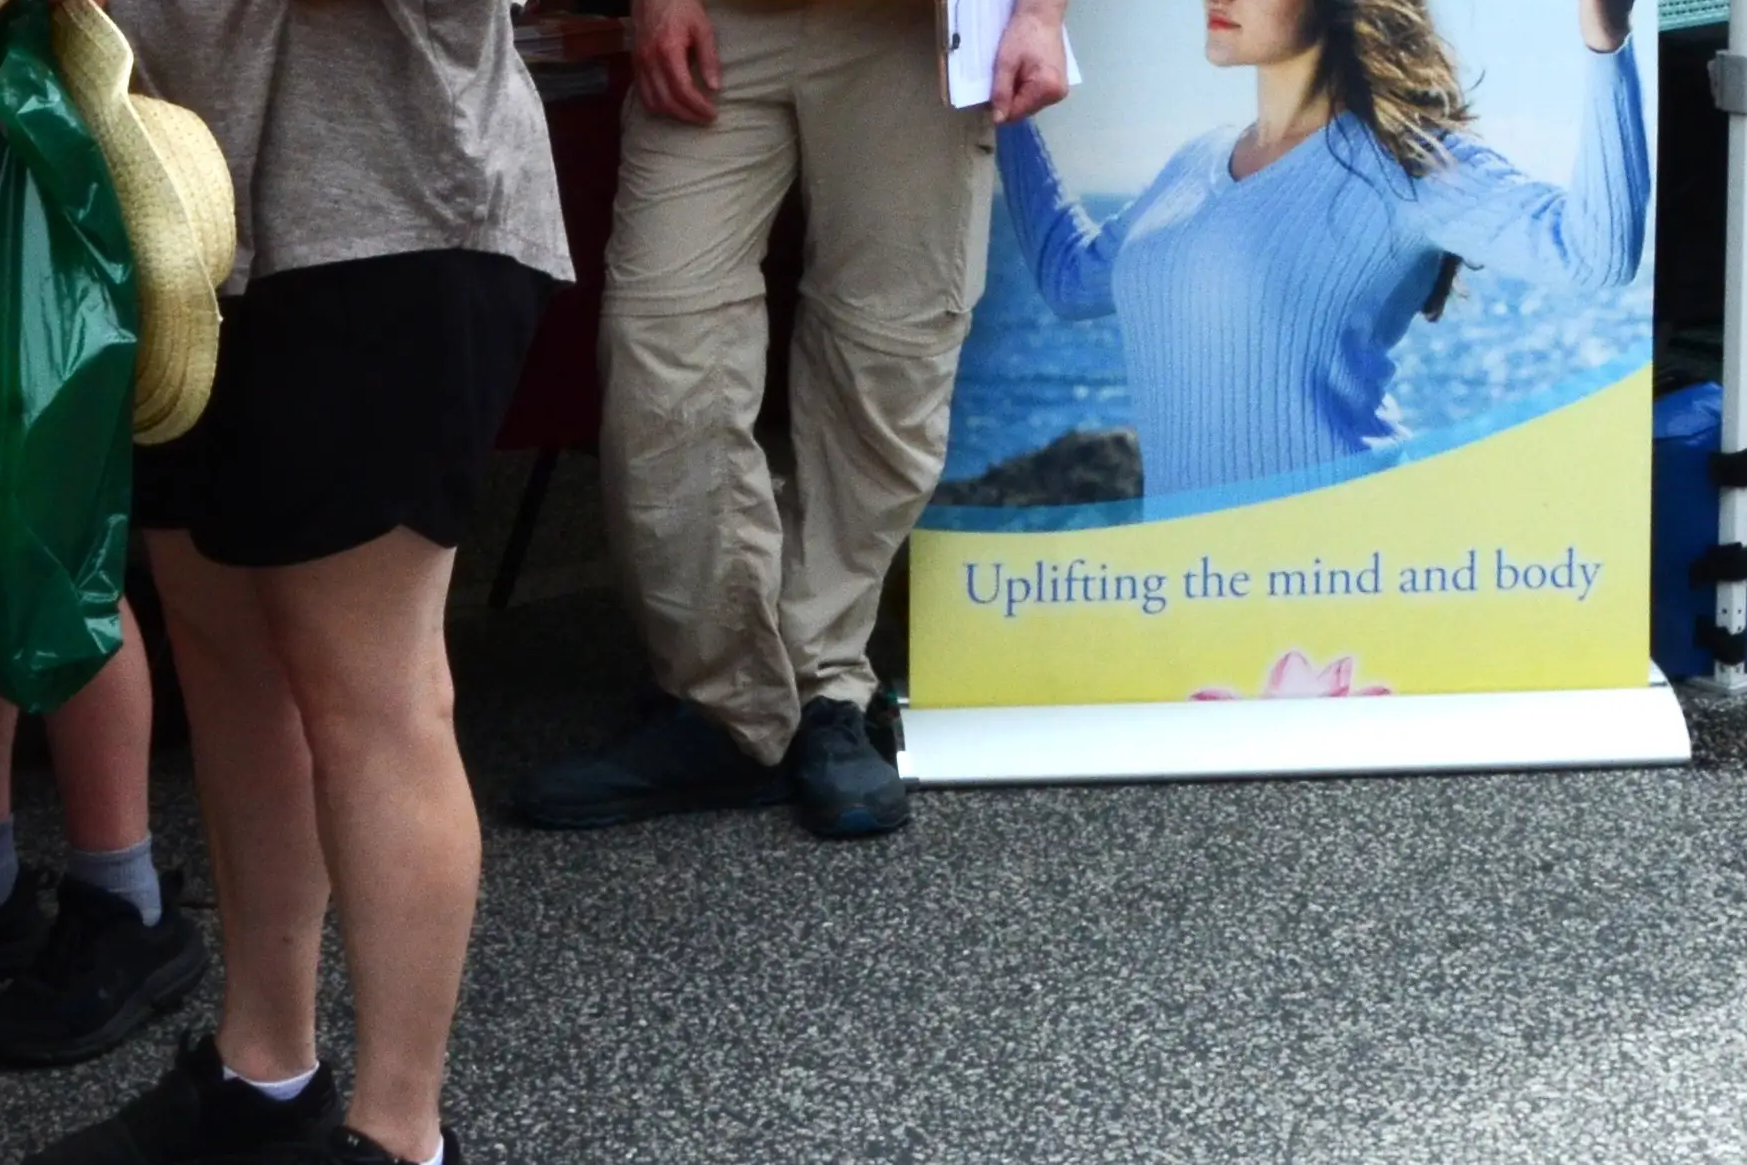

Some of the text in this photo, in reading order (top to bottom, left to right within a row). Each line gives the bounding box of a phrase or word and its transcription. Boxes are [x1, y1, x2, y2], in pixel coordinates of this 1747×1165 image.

[966, 547, 1604, 618] Uplifting the mind and body
